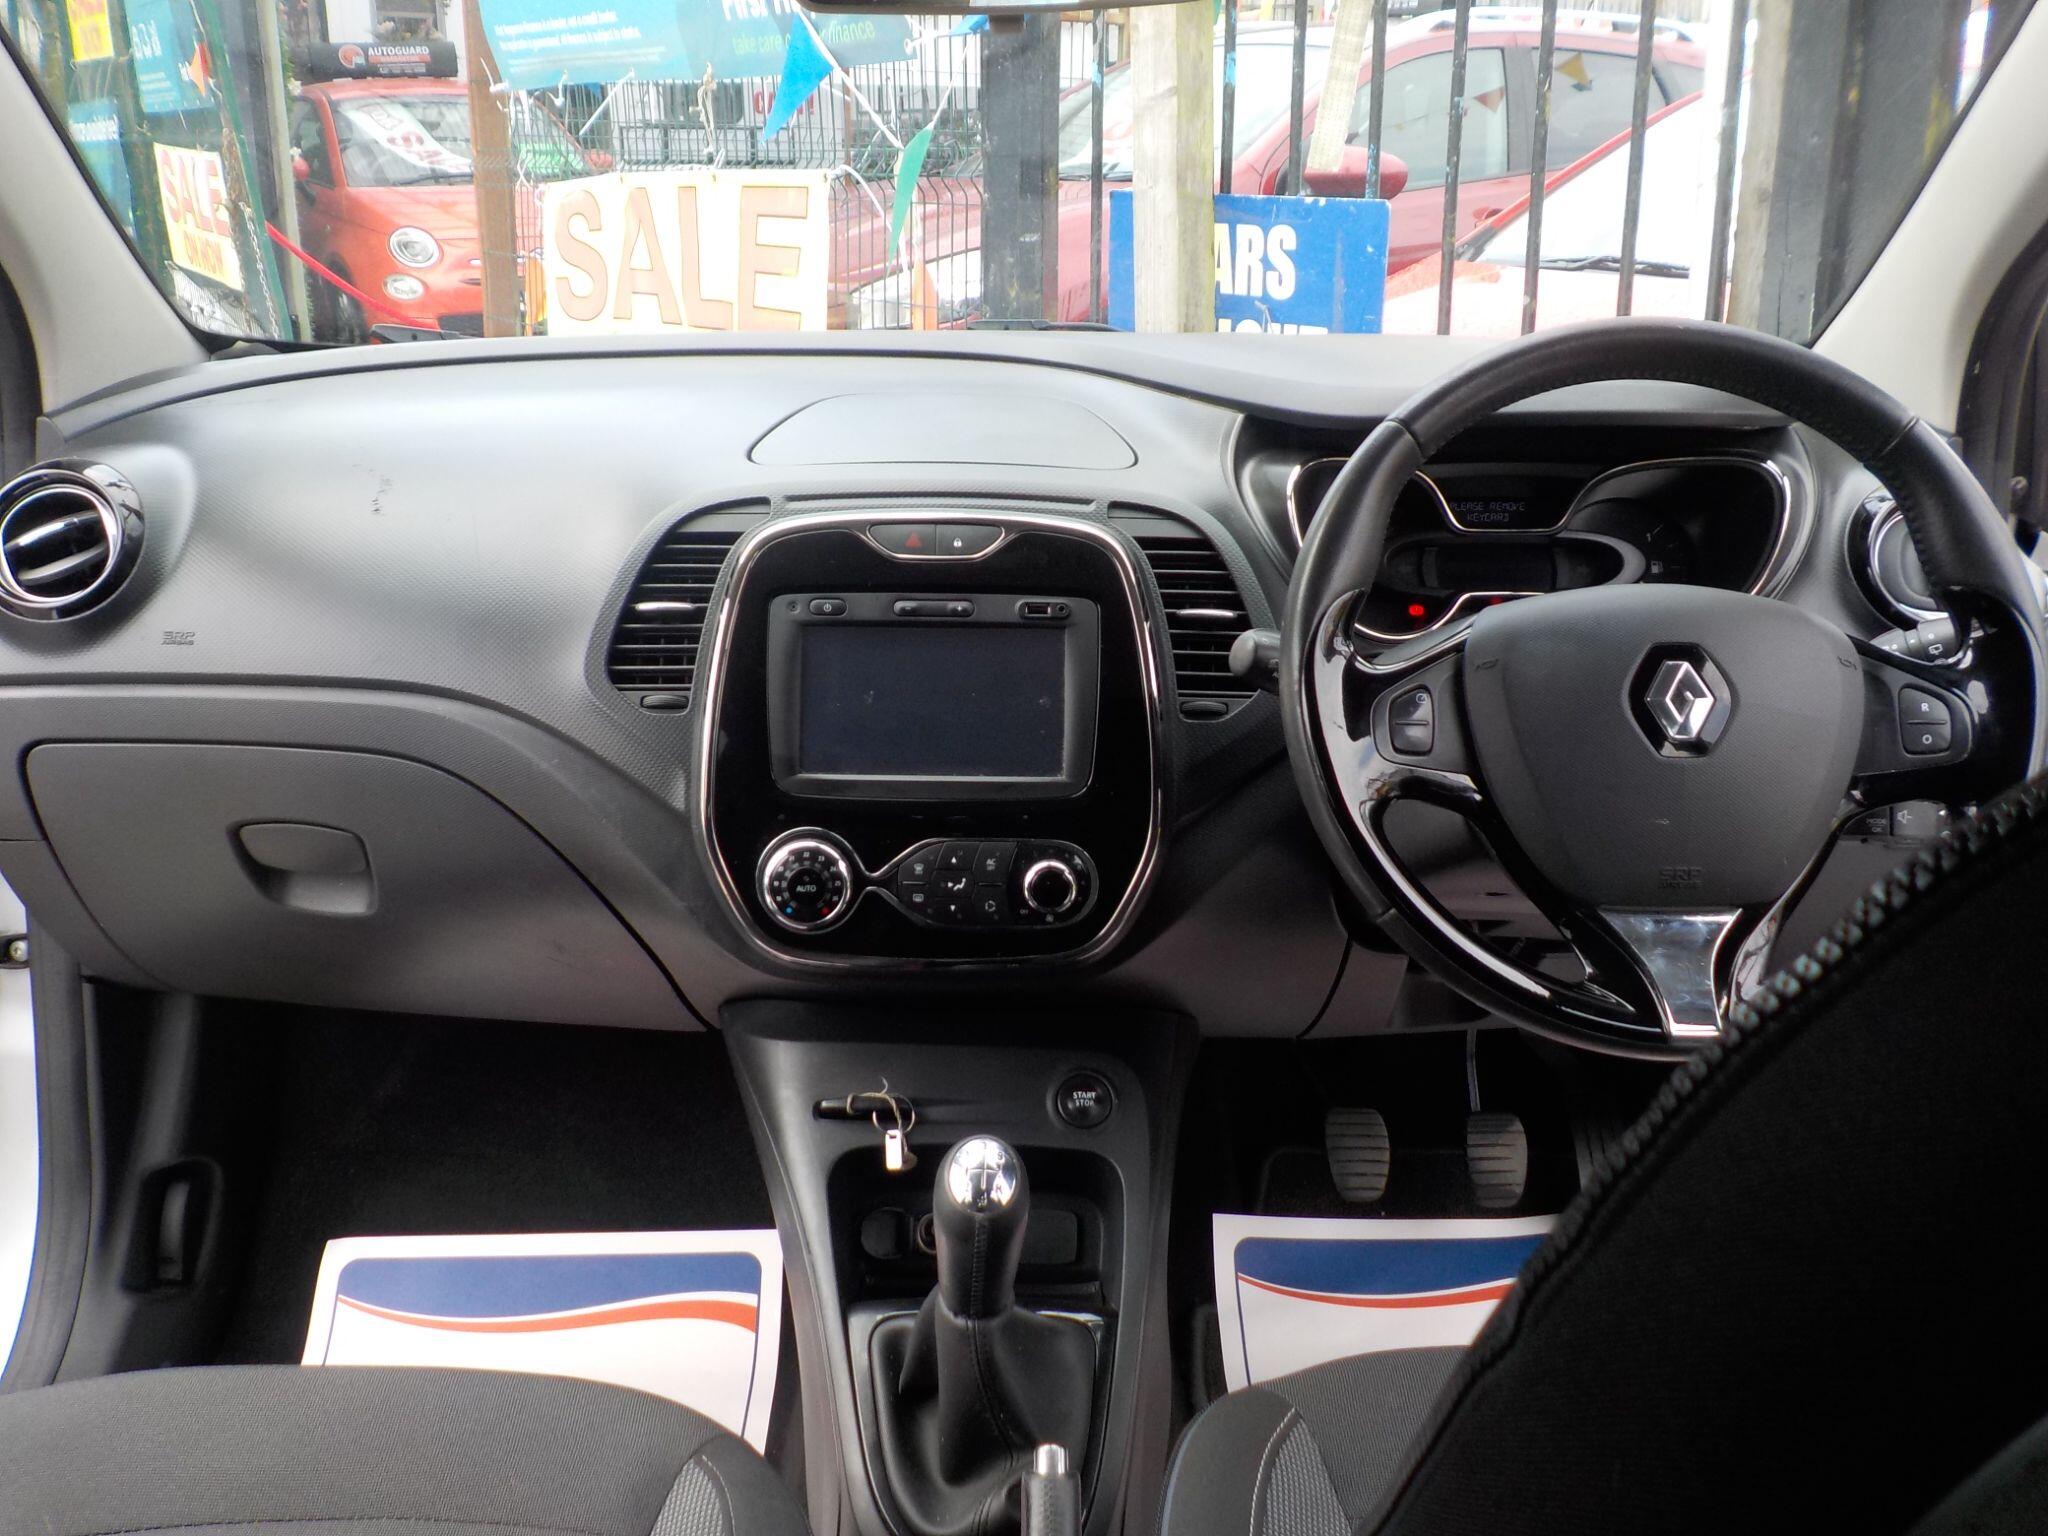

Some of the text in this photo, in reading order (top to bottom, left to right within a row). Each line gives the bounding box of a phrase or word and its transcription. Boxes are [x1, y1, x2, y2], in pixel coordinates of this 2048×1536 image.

[368, 46, 430, 56] AUTOGUARD
[161, 148, 232, 239] SALE
[554, 185, 809, 332] SALE
[1214, 222, 1297, 301] ARS
[1921, 702, 1930, 712] R
[795, 884, 817, 892] AUTO
[1073, 1091, 1097, 1099] START
[1075, 1098, 1095, 1107] STOP
